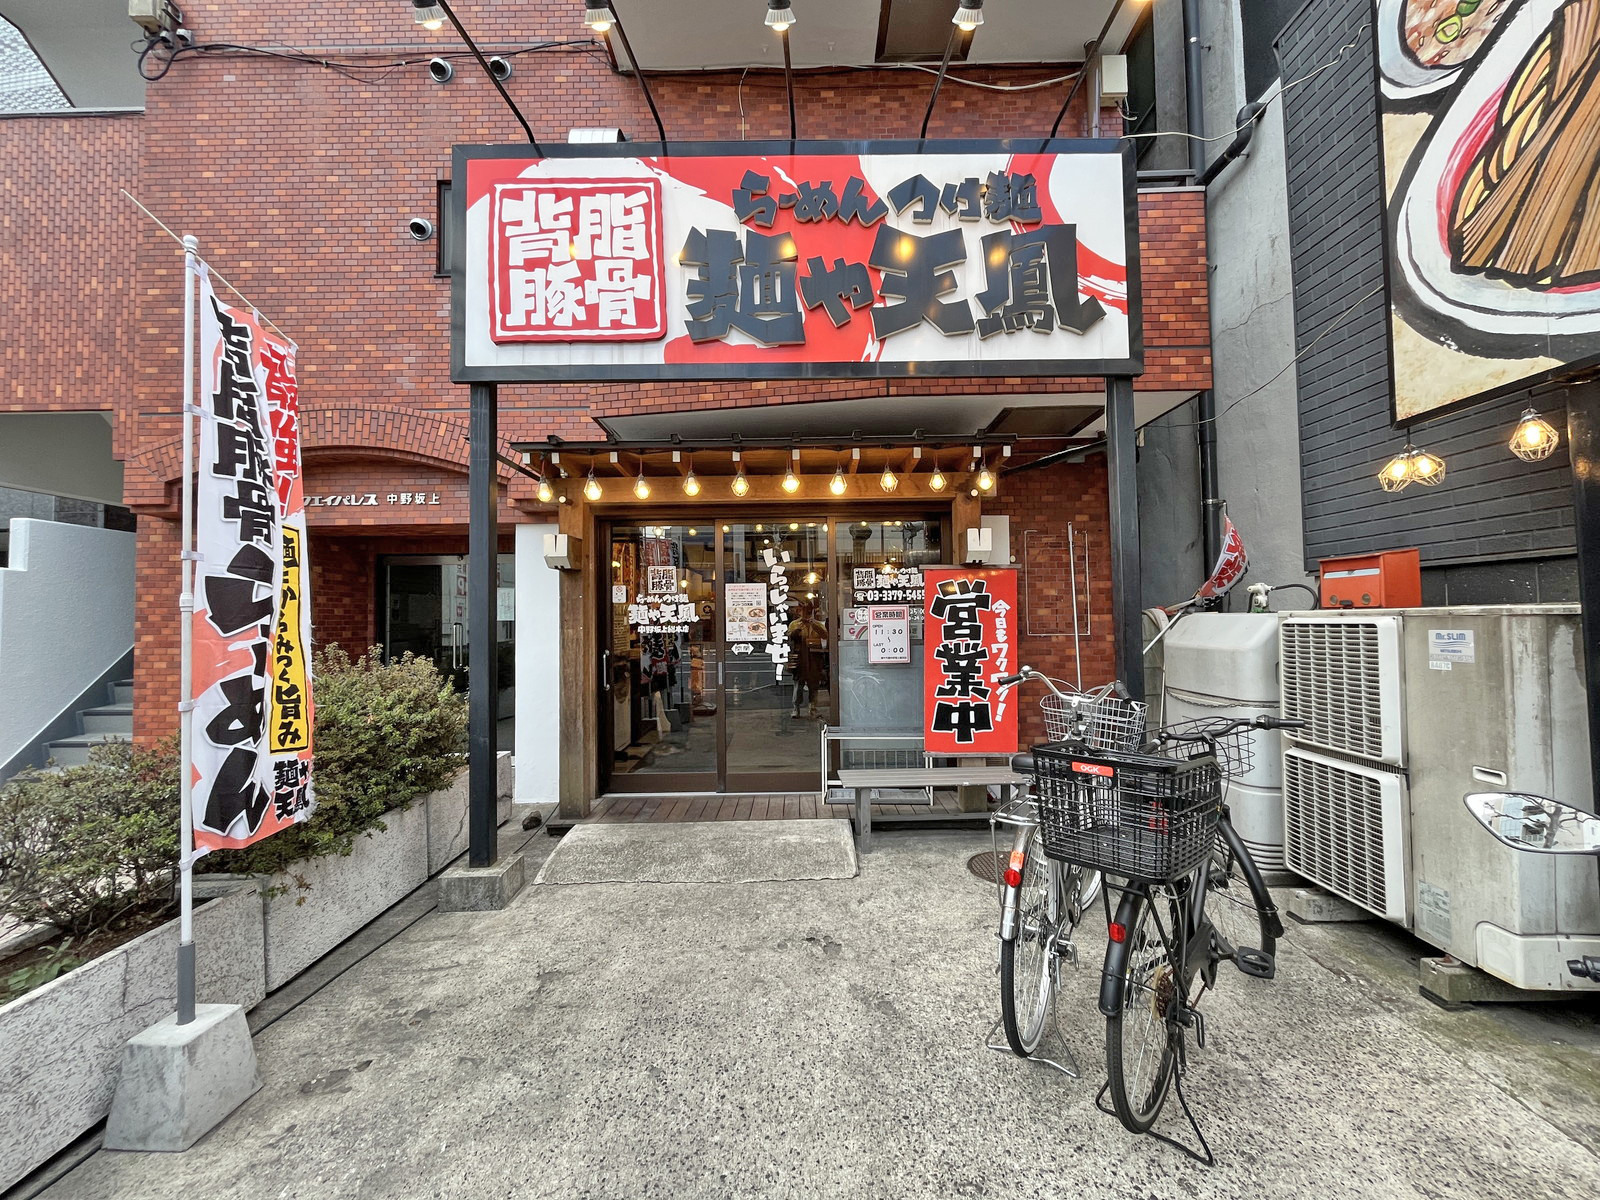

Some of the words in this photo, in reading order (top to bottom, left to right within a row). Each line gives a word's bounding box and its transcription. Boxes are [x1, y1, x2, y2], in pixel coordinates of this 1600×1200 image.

[500, 190, 649, 262] 背脂
[509, 259, 651, 326] 豚骨
[679, 223, 1107, 346] 麺や天鳳
[387, 493, 440, 505] 中野坂上
[628, 602, 700, 624] 麺や天鳳
[930, 579, 993, 743] 営業中
[1080, 764, 1101, 774] OGK
